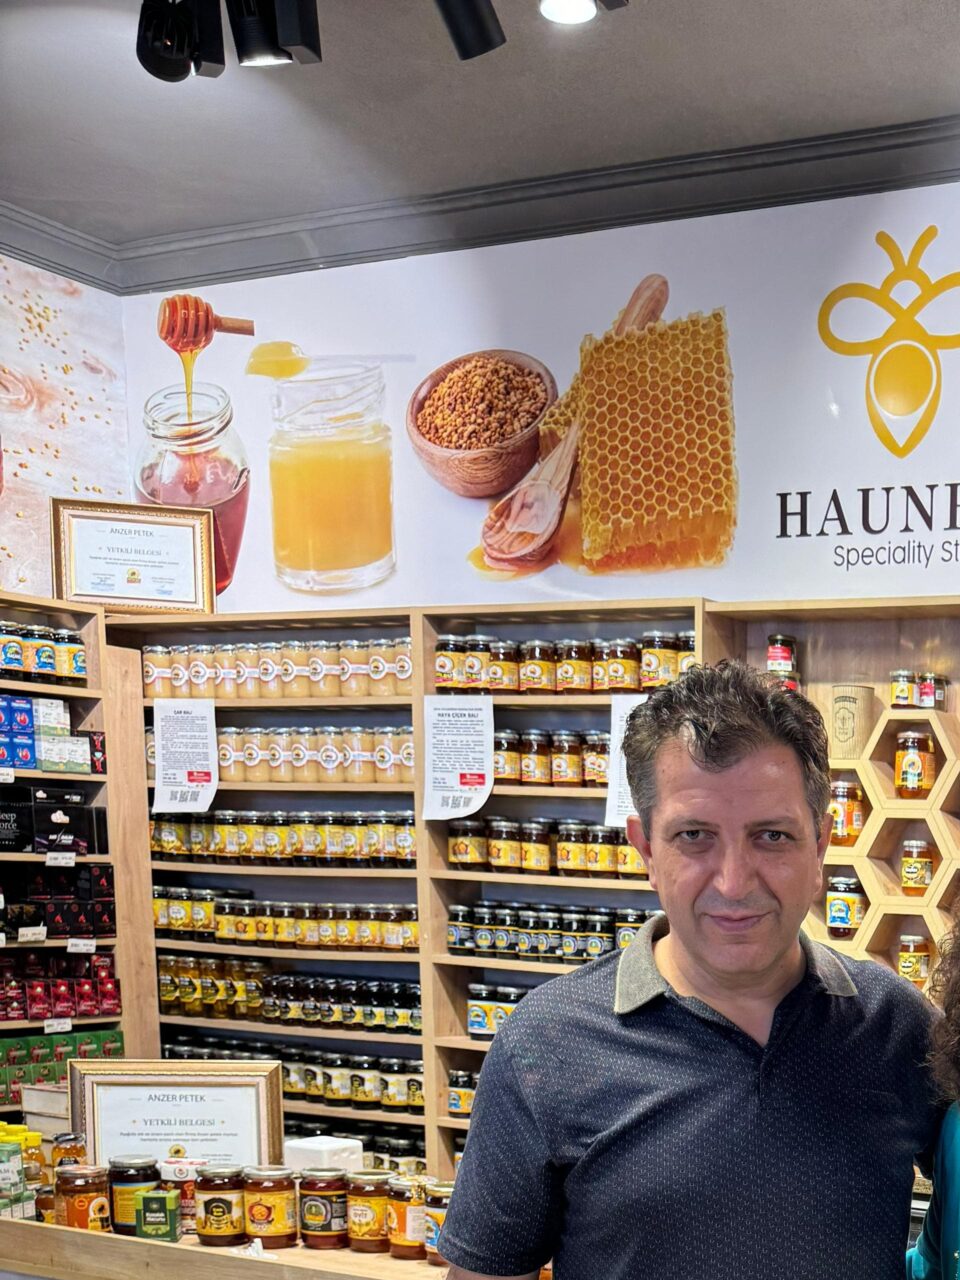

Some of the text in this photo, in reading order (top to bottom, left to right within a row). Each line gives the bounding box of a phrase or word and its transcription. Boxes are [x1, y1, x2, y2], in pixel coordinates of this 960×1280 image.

[110, 527, 154, 537] ANZER PETEK
[833, 540, 933, 571] Speciality
[0, 812, 17, 822] eep
[147, 1094, 206, 1102] ANZER PETEK
[143, 1118, 215, 1126] YETKİLİ BELGESİ
